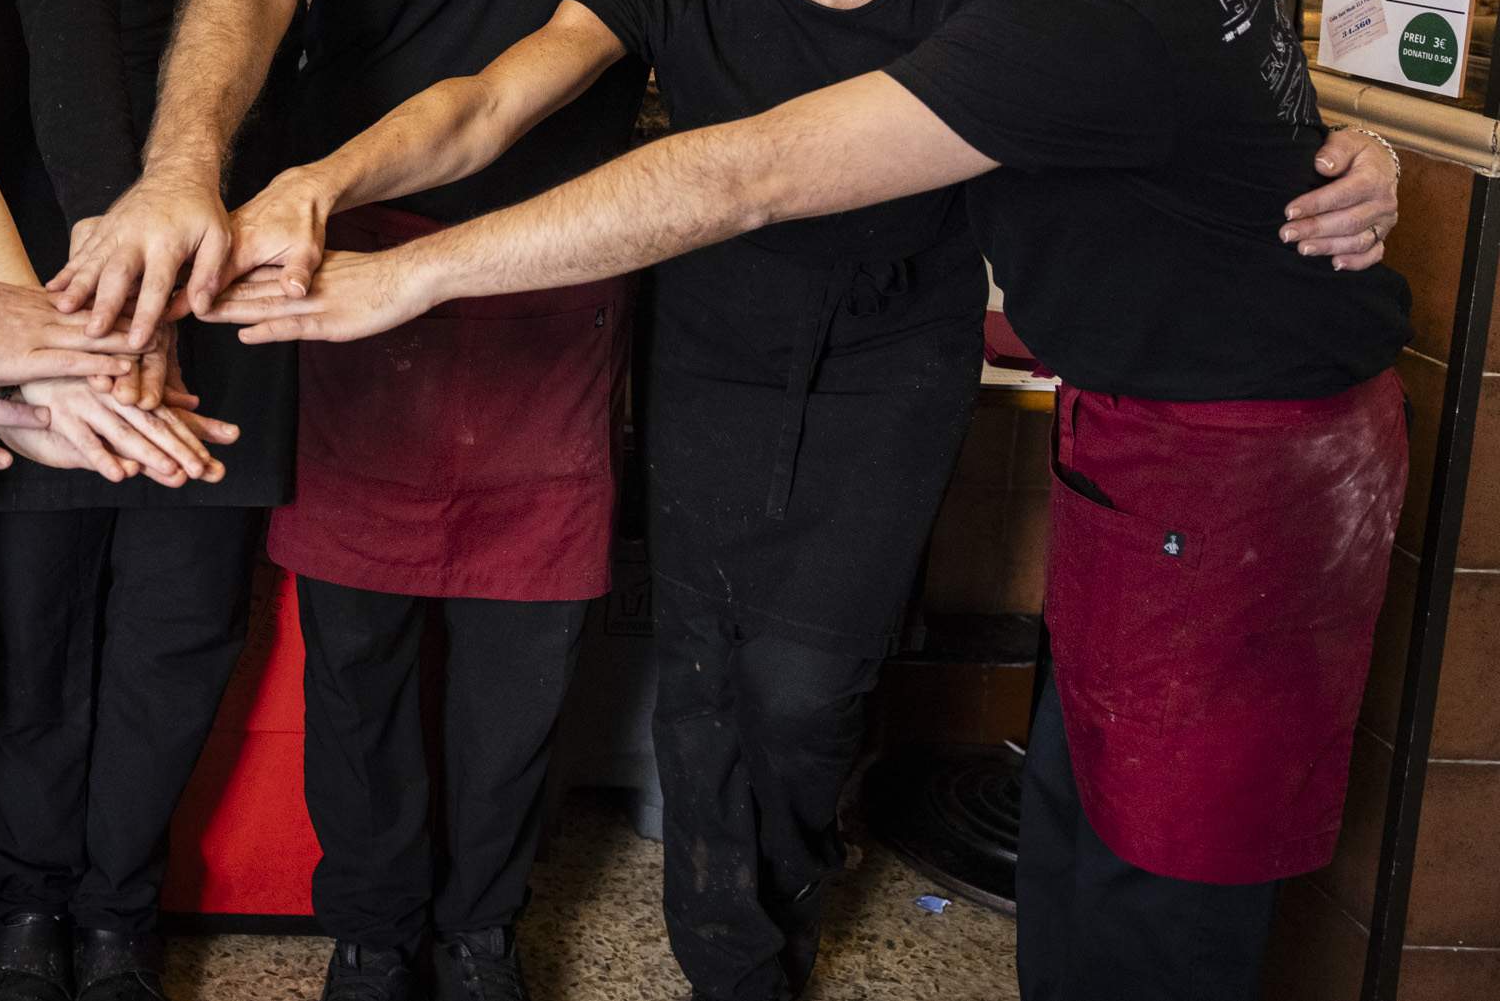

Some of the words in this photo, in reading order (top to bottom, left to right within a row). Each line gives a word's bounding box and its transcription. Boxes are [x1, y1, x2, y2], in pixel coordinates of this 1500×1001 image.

[1403, 31, 1426, 45] PREU
[1433, 37, 1447, 50] 3€
[1402, 48, 1433, 61] DONATIU
